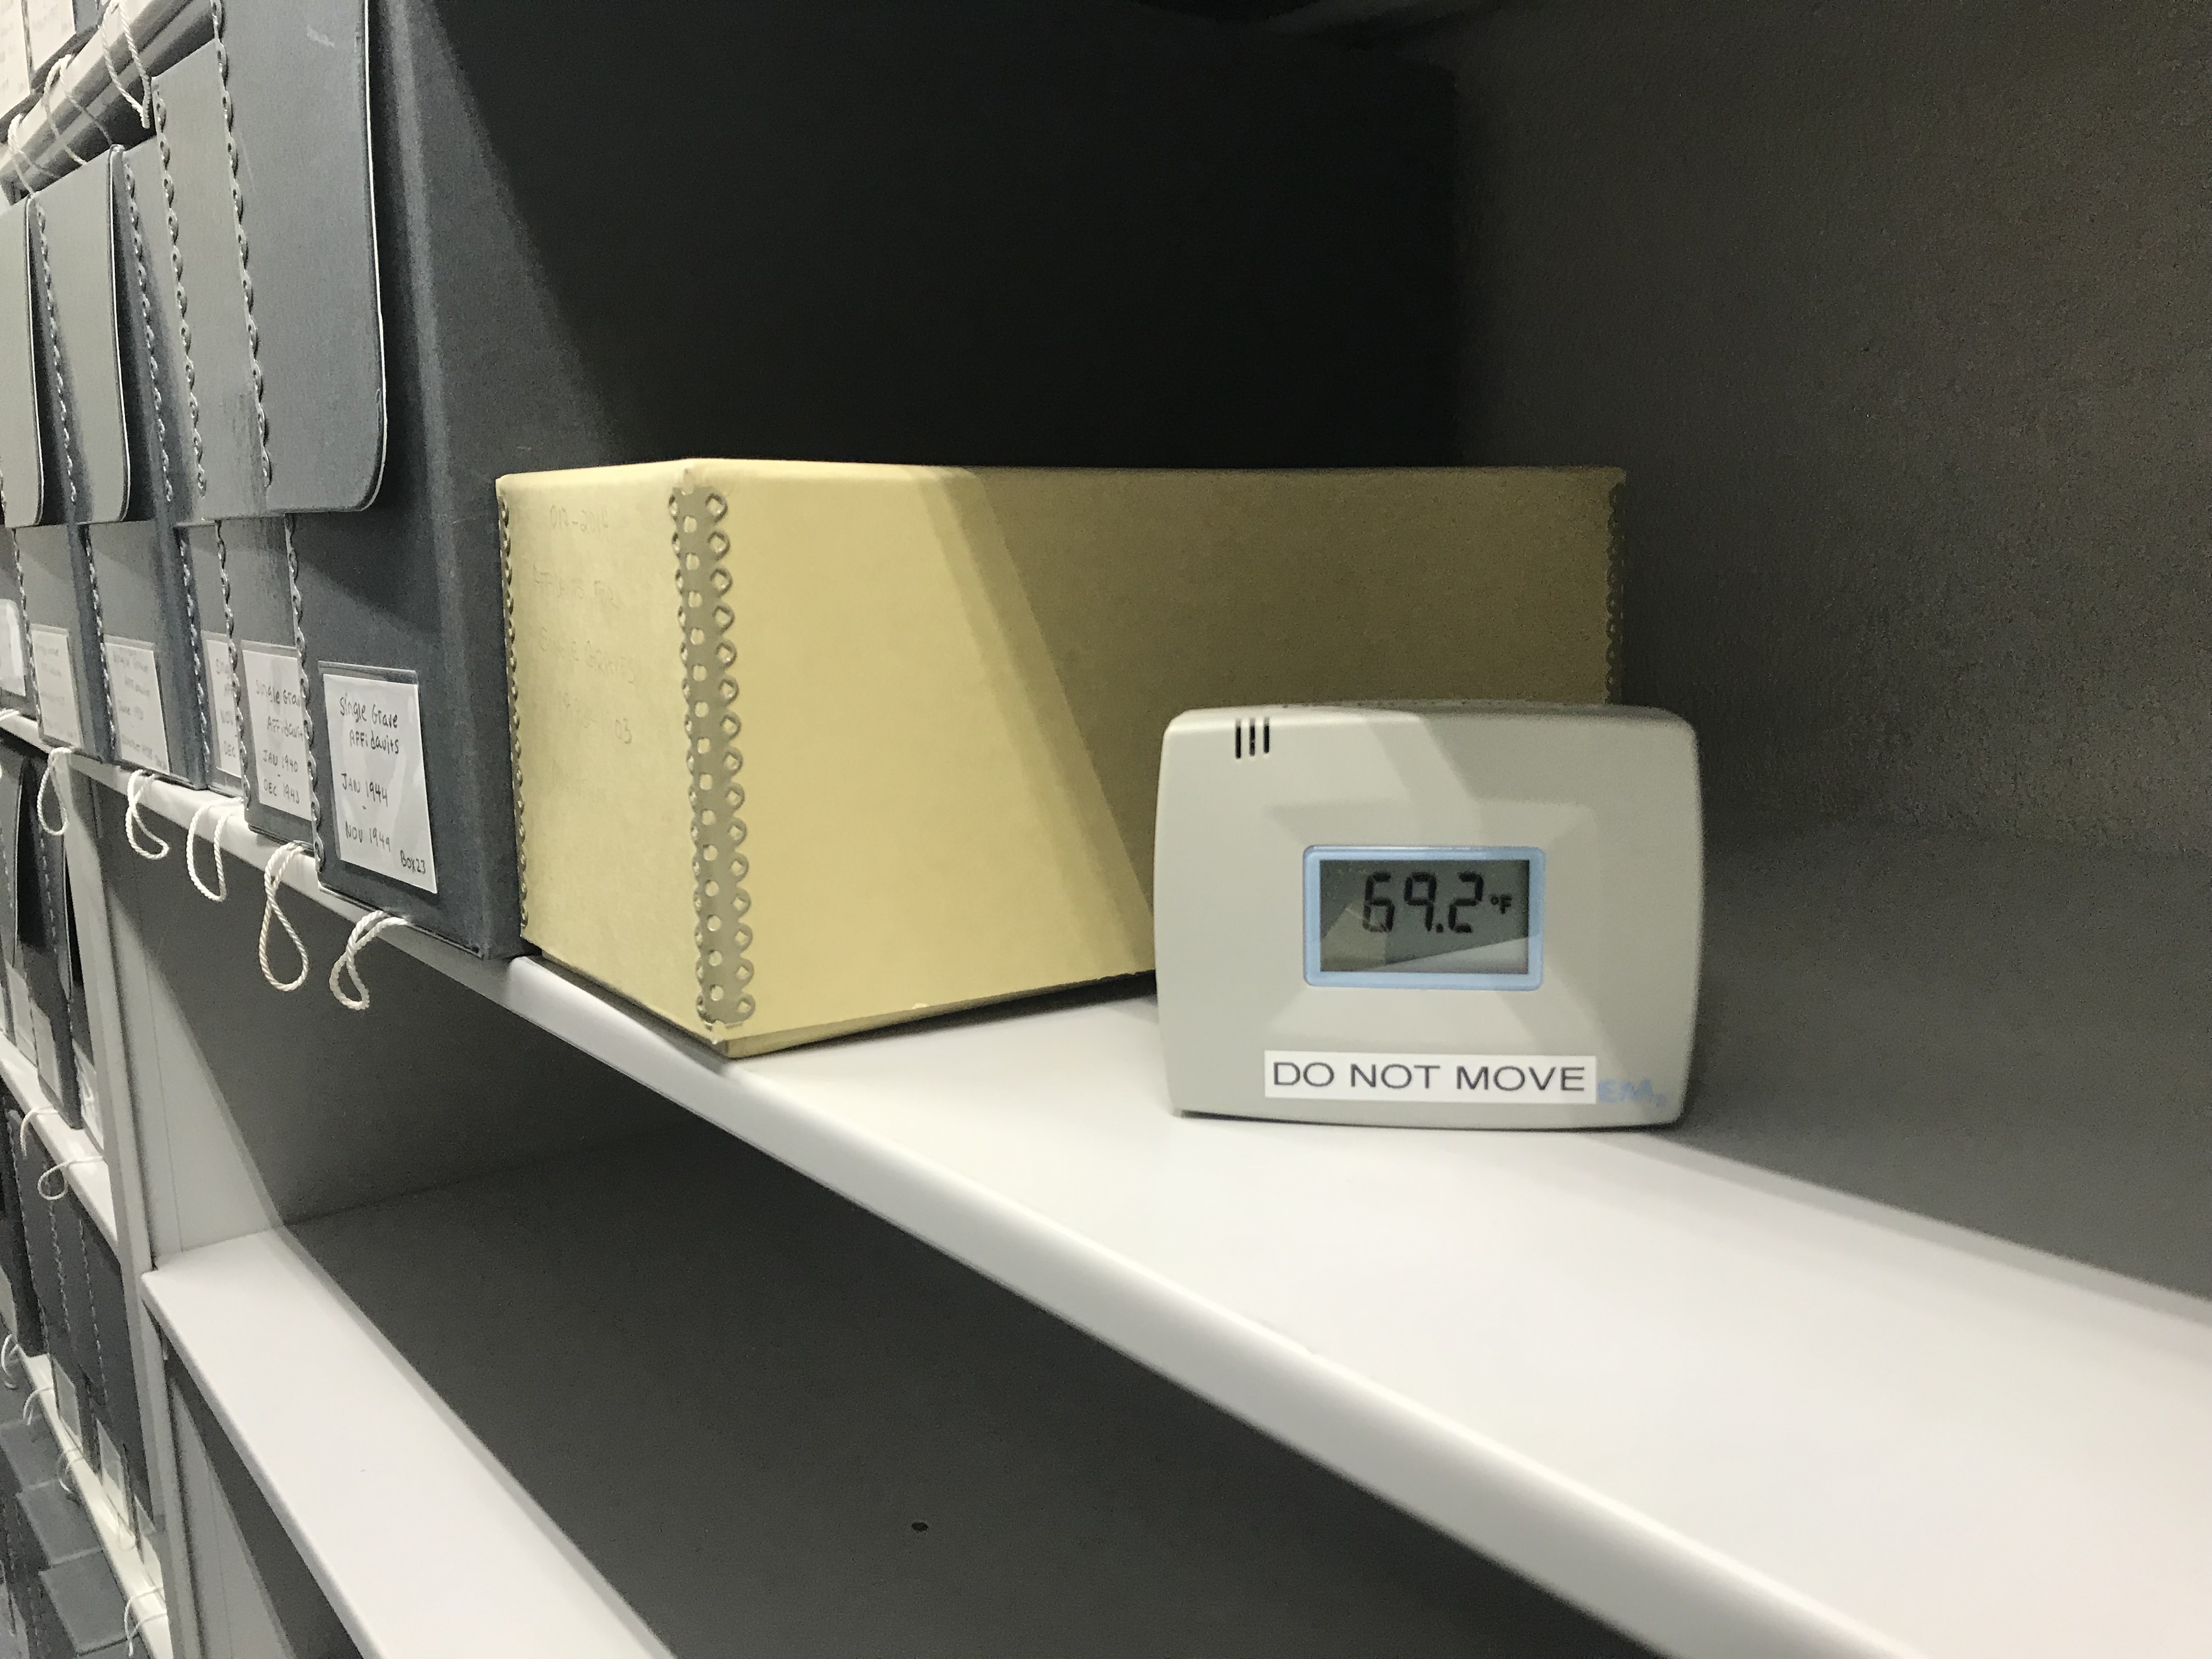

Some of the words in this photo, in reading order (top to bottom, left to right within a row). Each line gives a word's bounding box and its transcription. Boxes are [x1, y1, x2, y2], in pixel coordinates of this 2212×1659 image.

[340, 692, 367, 723] Single
[372, 703, 398, 729] Grave
[341, 773, 360, 793] JAN
[365, 781, 388, 808] 1944
[1273, 1062, 1334, 1087] DO
[1350, 1063, 1441, 1089] NOT
[1456, 1065, 1585, 1091] MOVE
